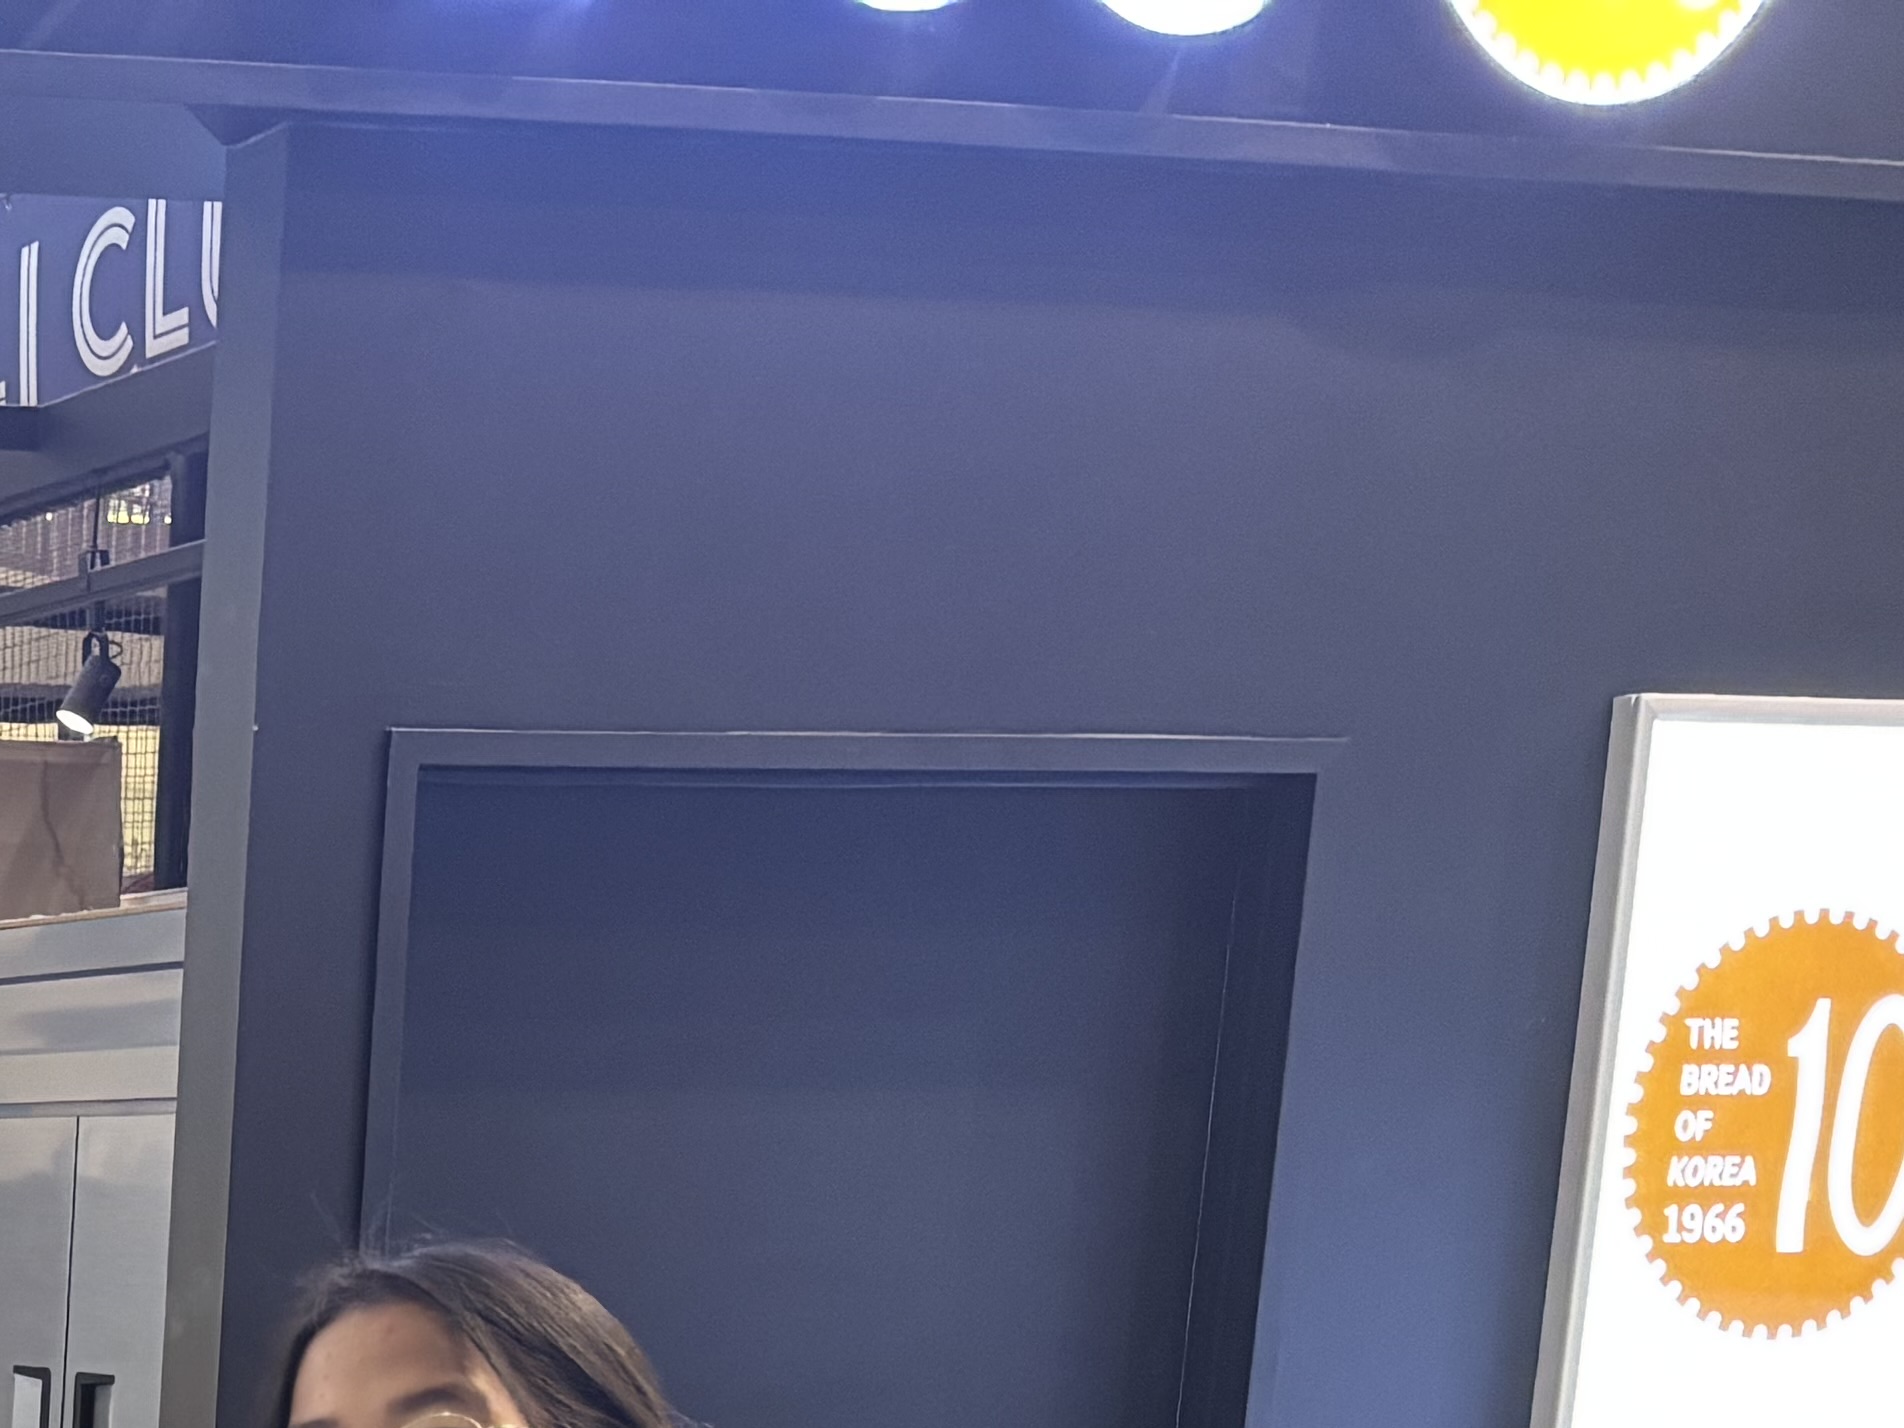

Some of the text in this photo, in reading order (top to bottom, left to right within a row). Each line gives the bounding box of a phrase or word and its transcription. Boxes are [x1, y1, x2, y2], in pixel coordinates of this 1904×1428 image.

[1684, 1017, 1739, 1050] THE
[1680, 1063, 1771, 1096] BREAD
[1674, 1110, 1714, 1142] OF
[1667, 1155, 1757, 1187] KOREA
[1662, 1203, 1745, 1243] 1966
